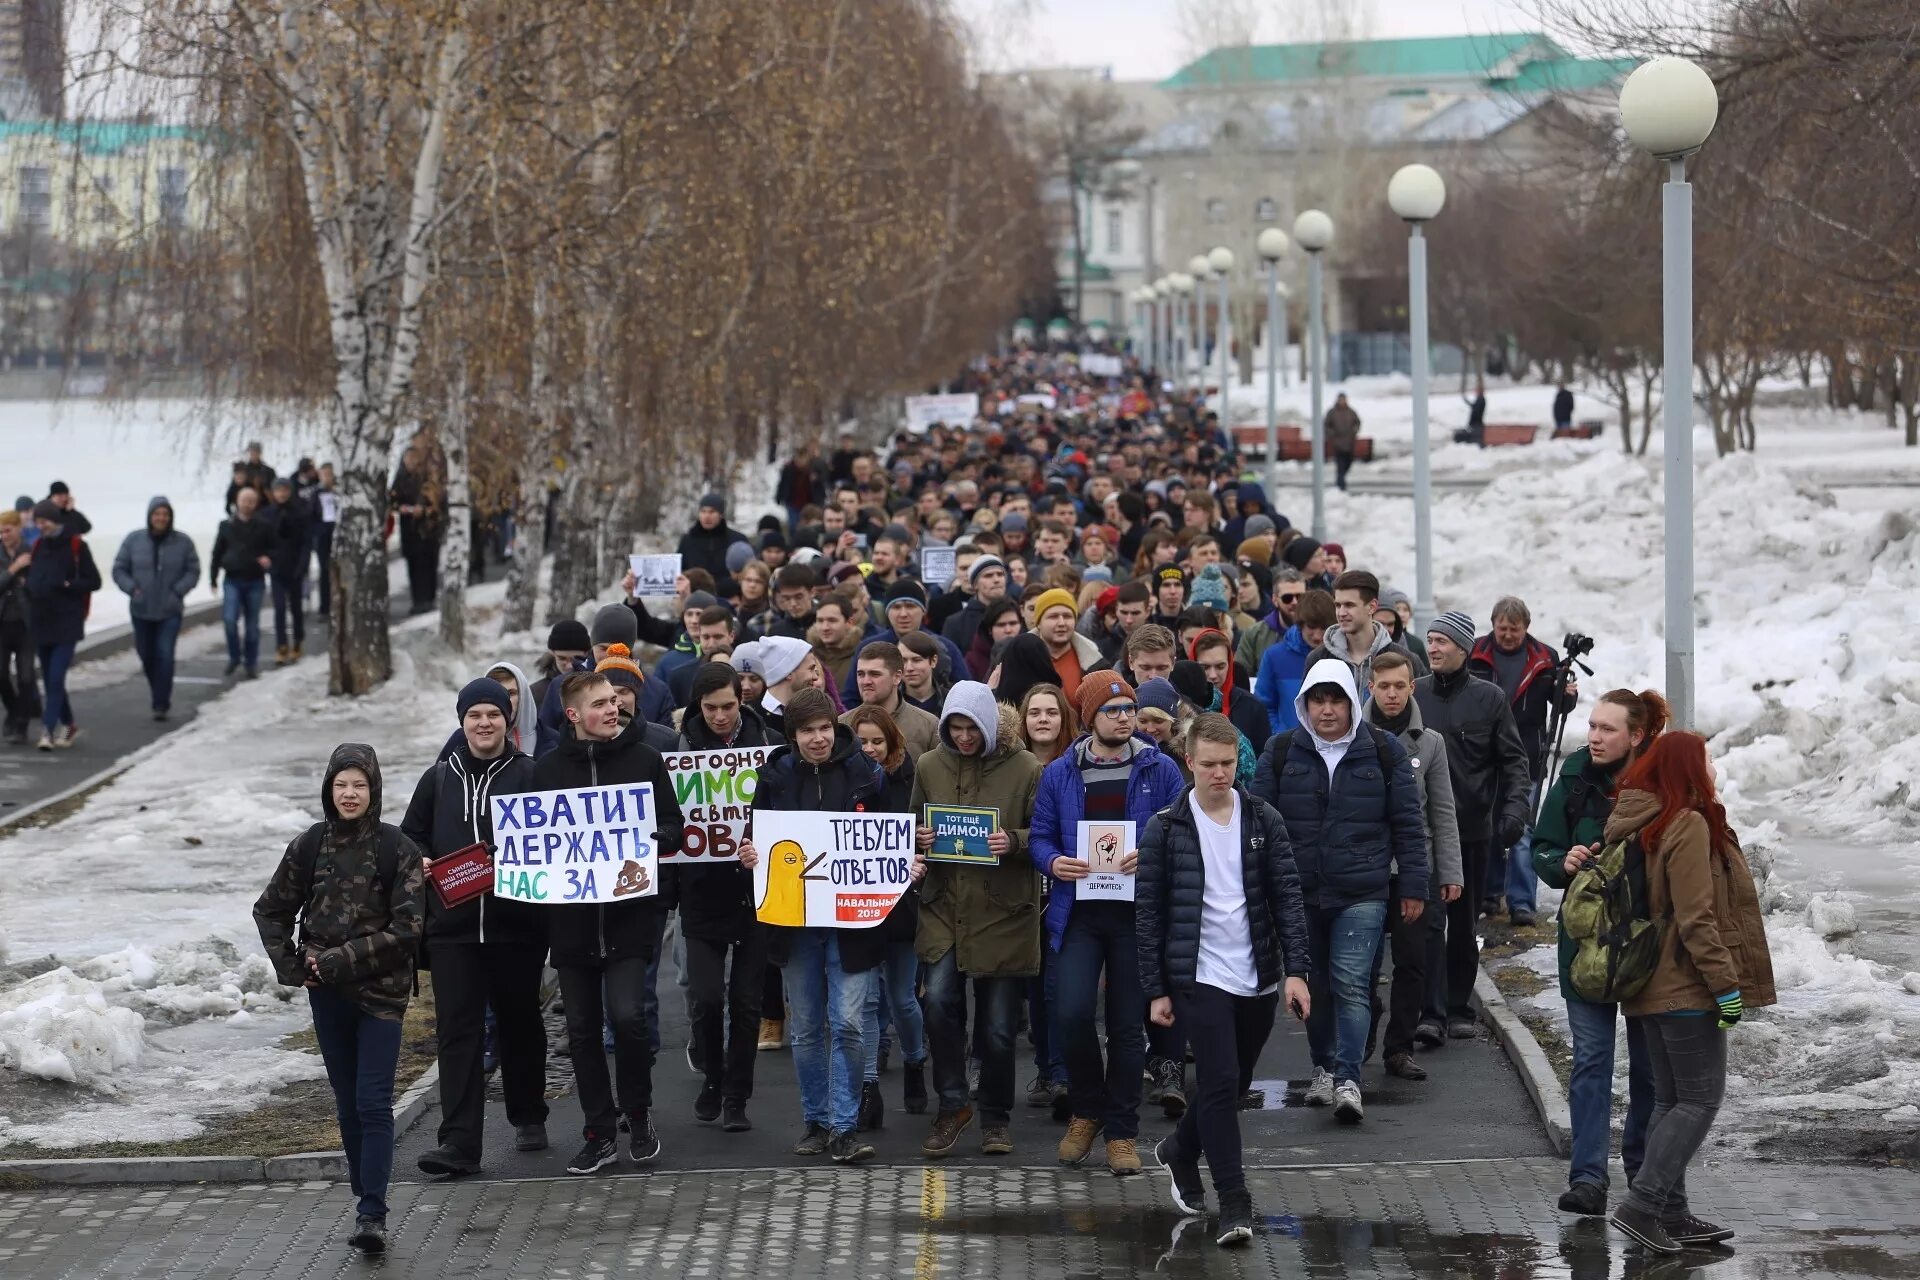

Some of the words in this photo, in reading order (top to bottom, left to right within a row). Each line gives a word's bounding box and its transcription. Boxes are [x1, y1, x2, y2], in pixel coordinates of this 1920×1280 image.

[664, 750, 765, 777] сегодня
[676, 769, 759, 805] ИМО
[496, 788, 650, 830] ХВАТИТ
[686, 804, 751, 823] автр
[945, 815, 962, 823] ТОТ
[962, 816, 980, 826] ЕЩЁ
[681, 823, 753, 857] ОВ
[829, 818, 911, 852] ТРЕБУЕМ
[936, 824, 988, 838] ДИМОН
[498, 827, 651, 867] ДЕРЖАТЬ
[439, 875, 456, 886] НАШ
[456, 863, 484, 880] ПРЕМЬЕР
[442, 866, 493, 892] КОРРУПЦИОНЕР
[447, 860, 477, 875] СЫНУЛЯ,
[830, 857, 910, 886] ОТВЕТОВ
[497, 868, 548, 900] НАС
[562, 868, 598, 900] ЗА
[837, 894, 902, 908] НАВАЛЬНЫЙ
